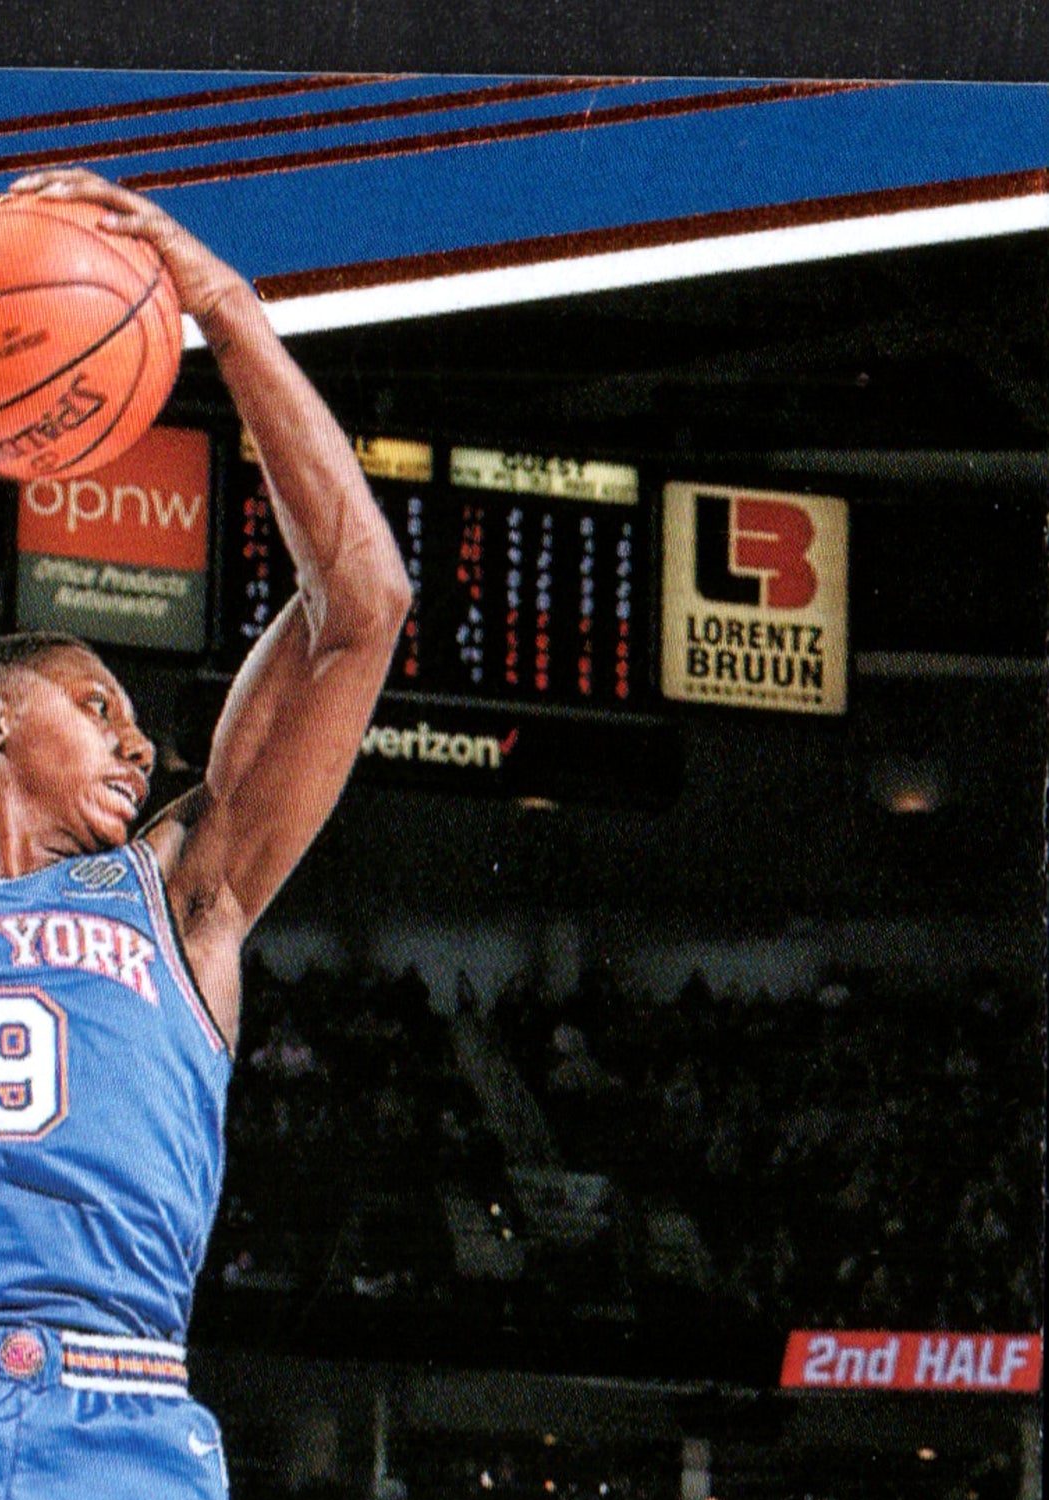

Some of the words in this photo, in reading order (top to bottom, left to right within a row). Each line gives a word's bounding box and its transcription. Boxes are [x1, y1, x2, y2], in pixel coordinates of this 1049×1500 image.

[26, 476, 202, 533] opnw
[687, 615, 823, 656] LORENTZ
[686, 647, 824, 689] BRUUN
[361, 720, 501, 769] verizon
[0, 911, 159, 1007] YORK
[803, 1335, 900, 1384] 2nd
[913, 1336, 1030, 1386] HALF
